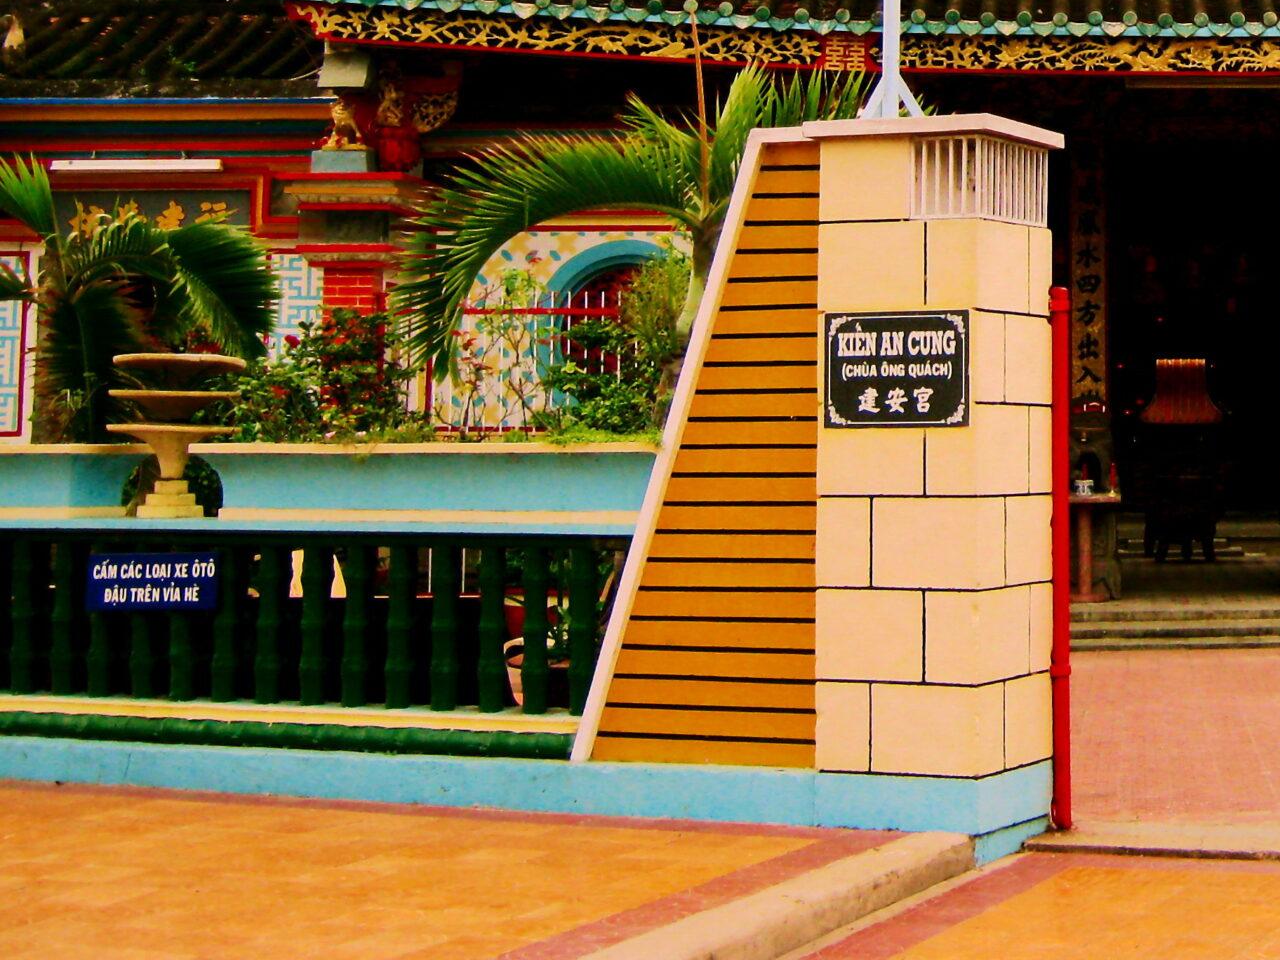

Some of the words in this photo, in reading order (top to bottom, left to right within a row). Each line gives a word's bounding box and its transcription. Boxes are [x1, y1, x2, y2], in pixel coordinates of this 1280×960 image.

[880, 331, 905, 356] AN
[908, 330, 956, 355] CUNG
[841, 361, 877, 381] (CHÙA
[880, 361, 905, 377] ÔNG
[908, 360, 952, 380] QUÁCH)
[93, 559, 118, 579] CẤM
[120, 560, 143, 579] CÁC
[145, 563, 171, 581] LOẠI
[174, 563, 189, 578] XE
[191, 558, 216, 578] ÔTÔ
[104, 584, 127, 606] ĐẬU
[130, 583, 160, 602] TRÊN
[163, 581, 181, 602] VỈA
[184, 583, 200, 602] HÈ
